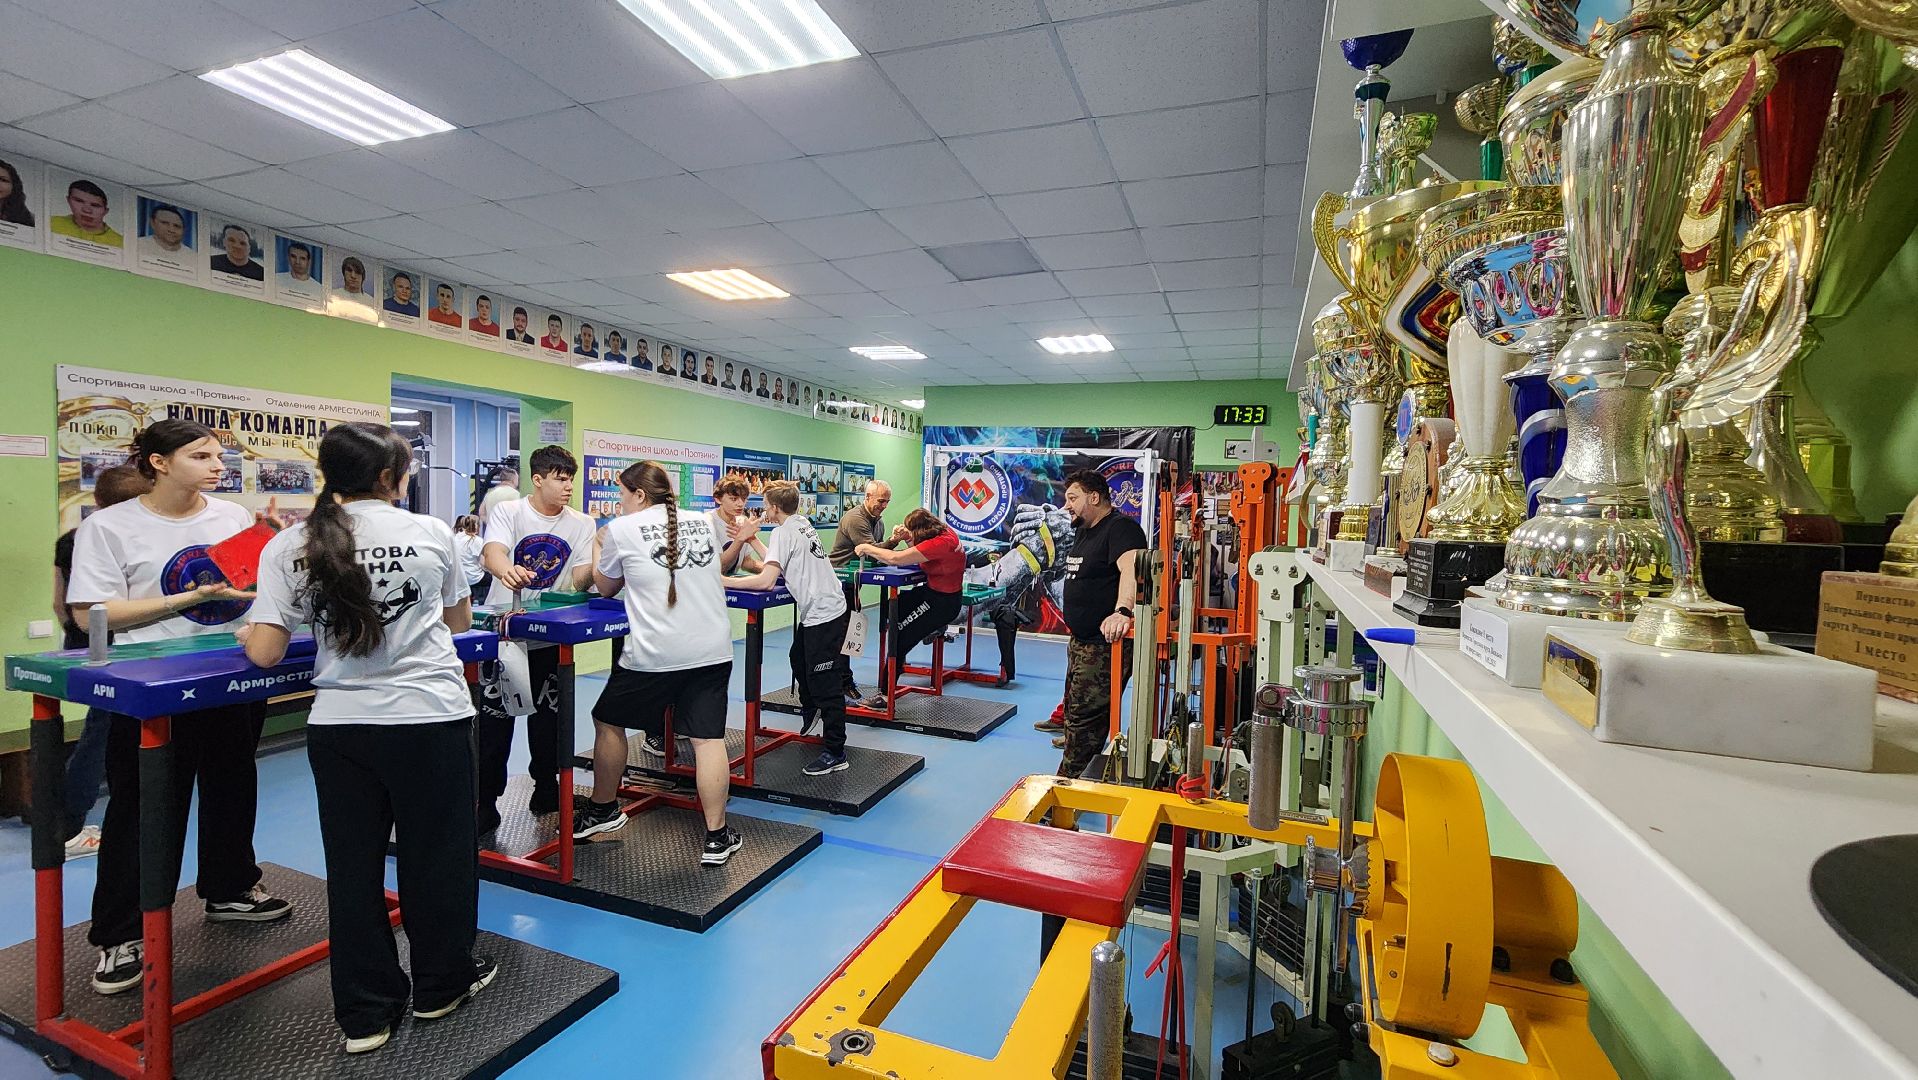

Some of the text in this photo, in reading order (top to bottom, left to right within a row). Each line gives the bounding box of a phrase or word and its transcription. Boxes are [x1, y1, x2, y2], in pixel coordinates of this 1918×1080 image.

[67, 373, 381, 418] Спортивная школа «Протвино» Отделение АРМРЕСТЛИНГА
[167, 404, 231, 429] НАША
[240, 411, 329, 440] КОМАНДА
[1223, 406, 1265, 423] 17:33
[69, 421, 118, 435] ПОКА
[248, 436, 271, 447] МЫ
[597, 439, 652, 454] Спортивная
[653, 447, 679, 456] школа
[638, 519, 709, 534] БАХРЕВА
[642, 527, 712, 543] ВАСЛИСА
[726, 595, 738, 603] РМ
[527, 621, 629, 634] АРМ Армре
[1864, 645, 1907, 663] место
[13, 666, 52, 684] Протвино
[93, 683, 115, 699] АРМ
